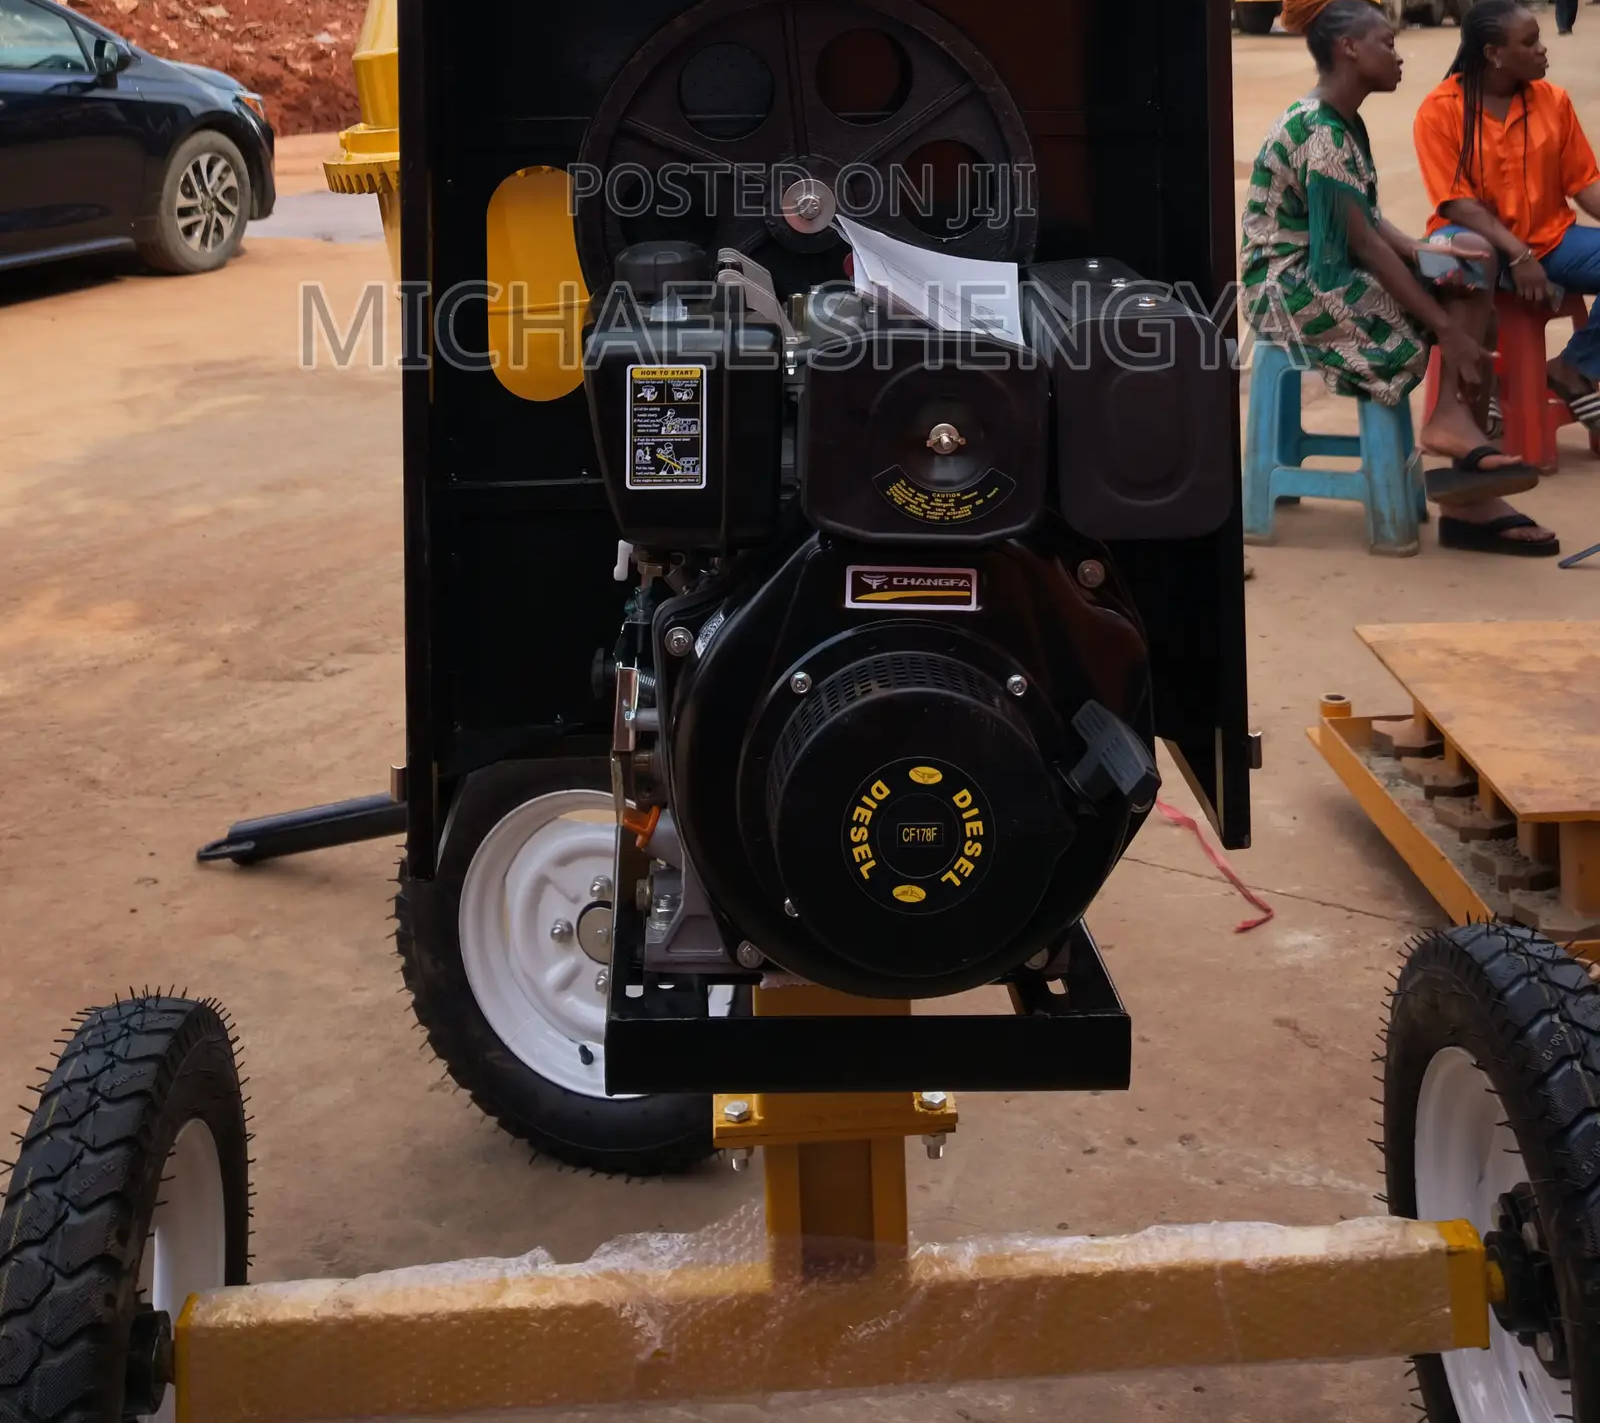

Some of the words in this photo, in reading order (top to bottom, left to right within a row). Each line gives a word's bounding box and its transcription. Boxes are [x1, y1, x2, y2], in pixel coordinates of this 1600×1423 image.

[892, 577, 970, 587] CHANGFA
[850, 779, 891, 880] DIESEL
[902, 827, 938, 842] CF178F
[940, 788, 984, 887] DIESEL
